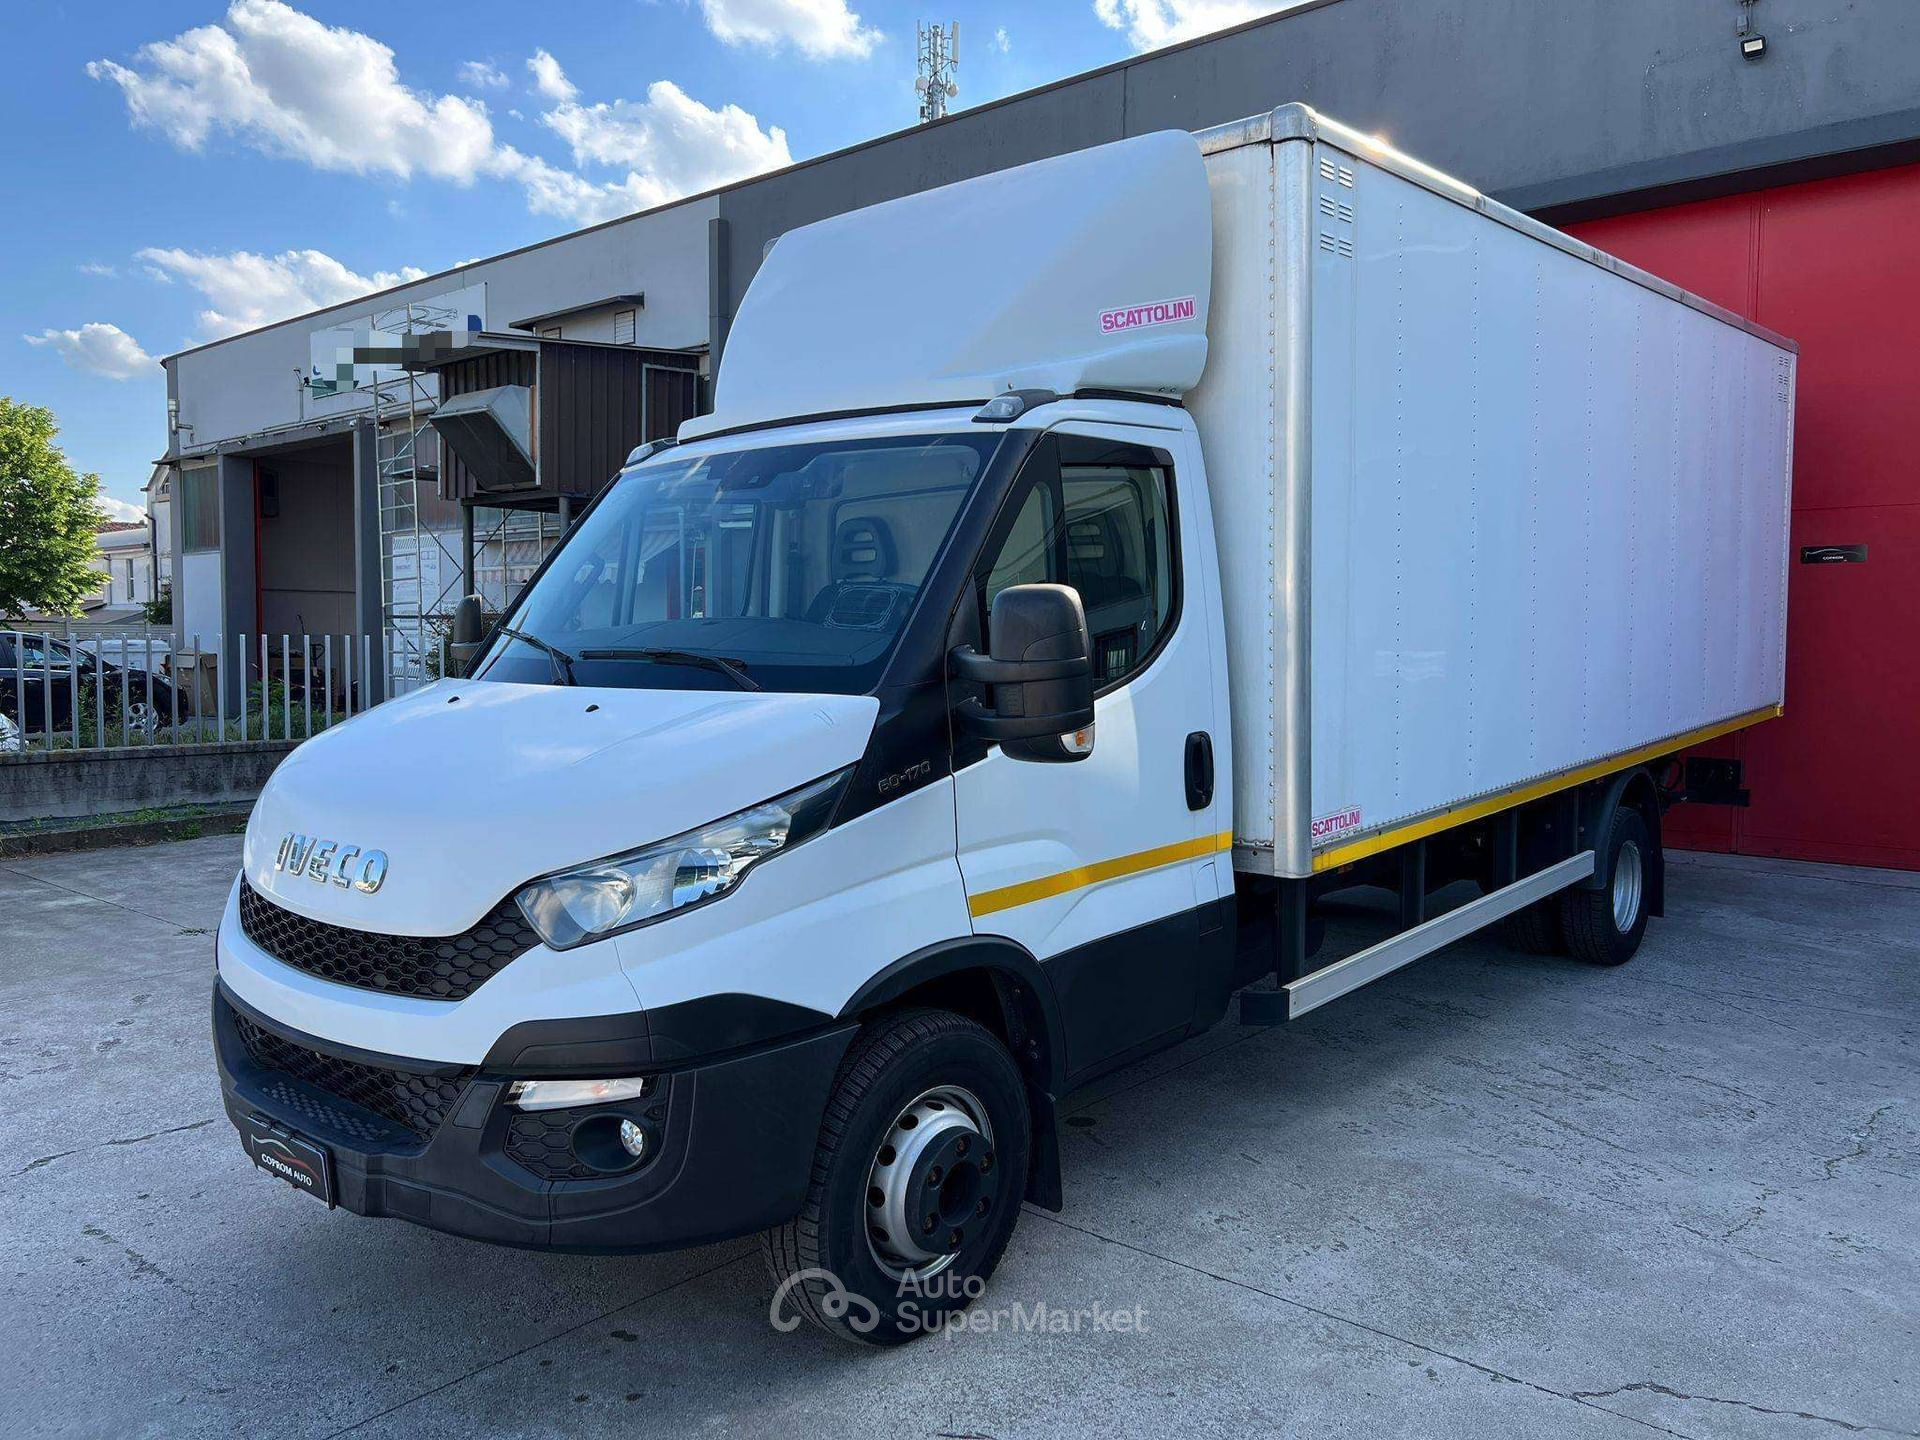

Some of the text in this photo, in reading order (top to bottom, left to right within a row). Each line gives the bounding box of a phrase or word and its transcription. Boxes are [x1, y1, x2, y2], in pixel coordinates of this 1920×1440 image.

[1101, 300, 1194, 331] SCATTOLINI
[1312, 810, 1361, 837] SCATTOLINI
[274, 831, 389, 894] IVECO
[261, 1153, 313, 1187] COPROM AUTO
